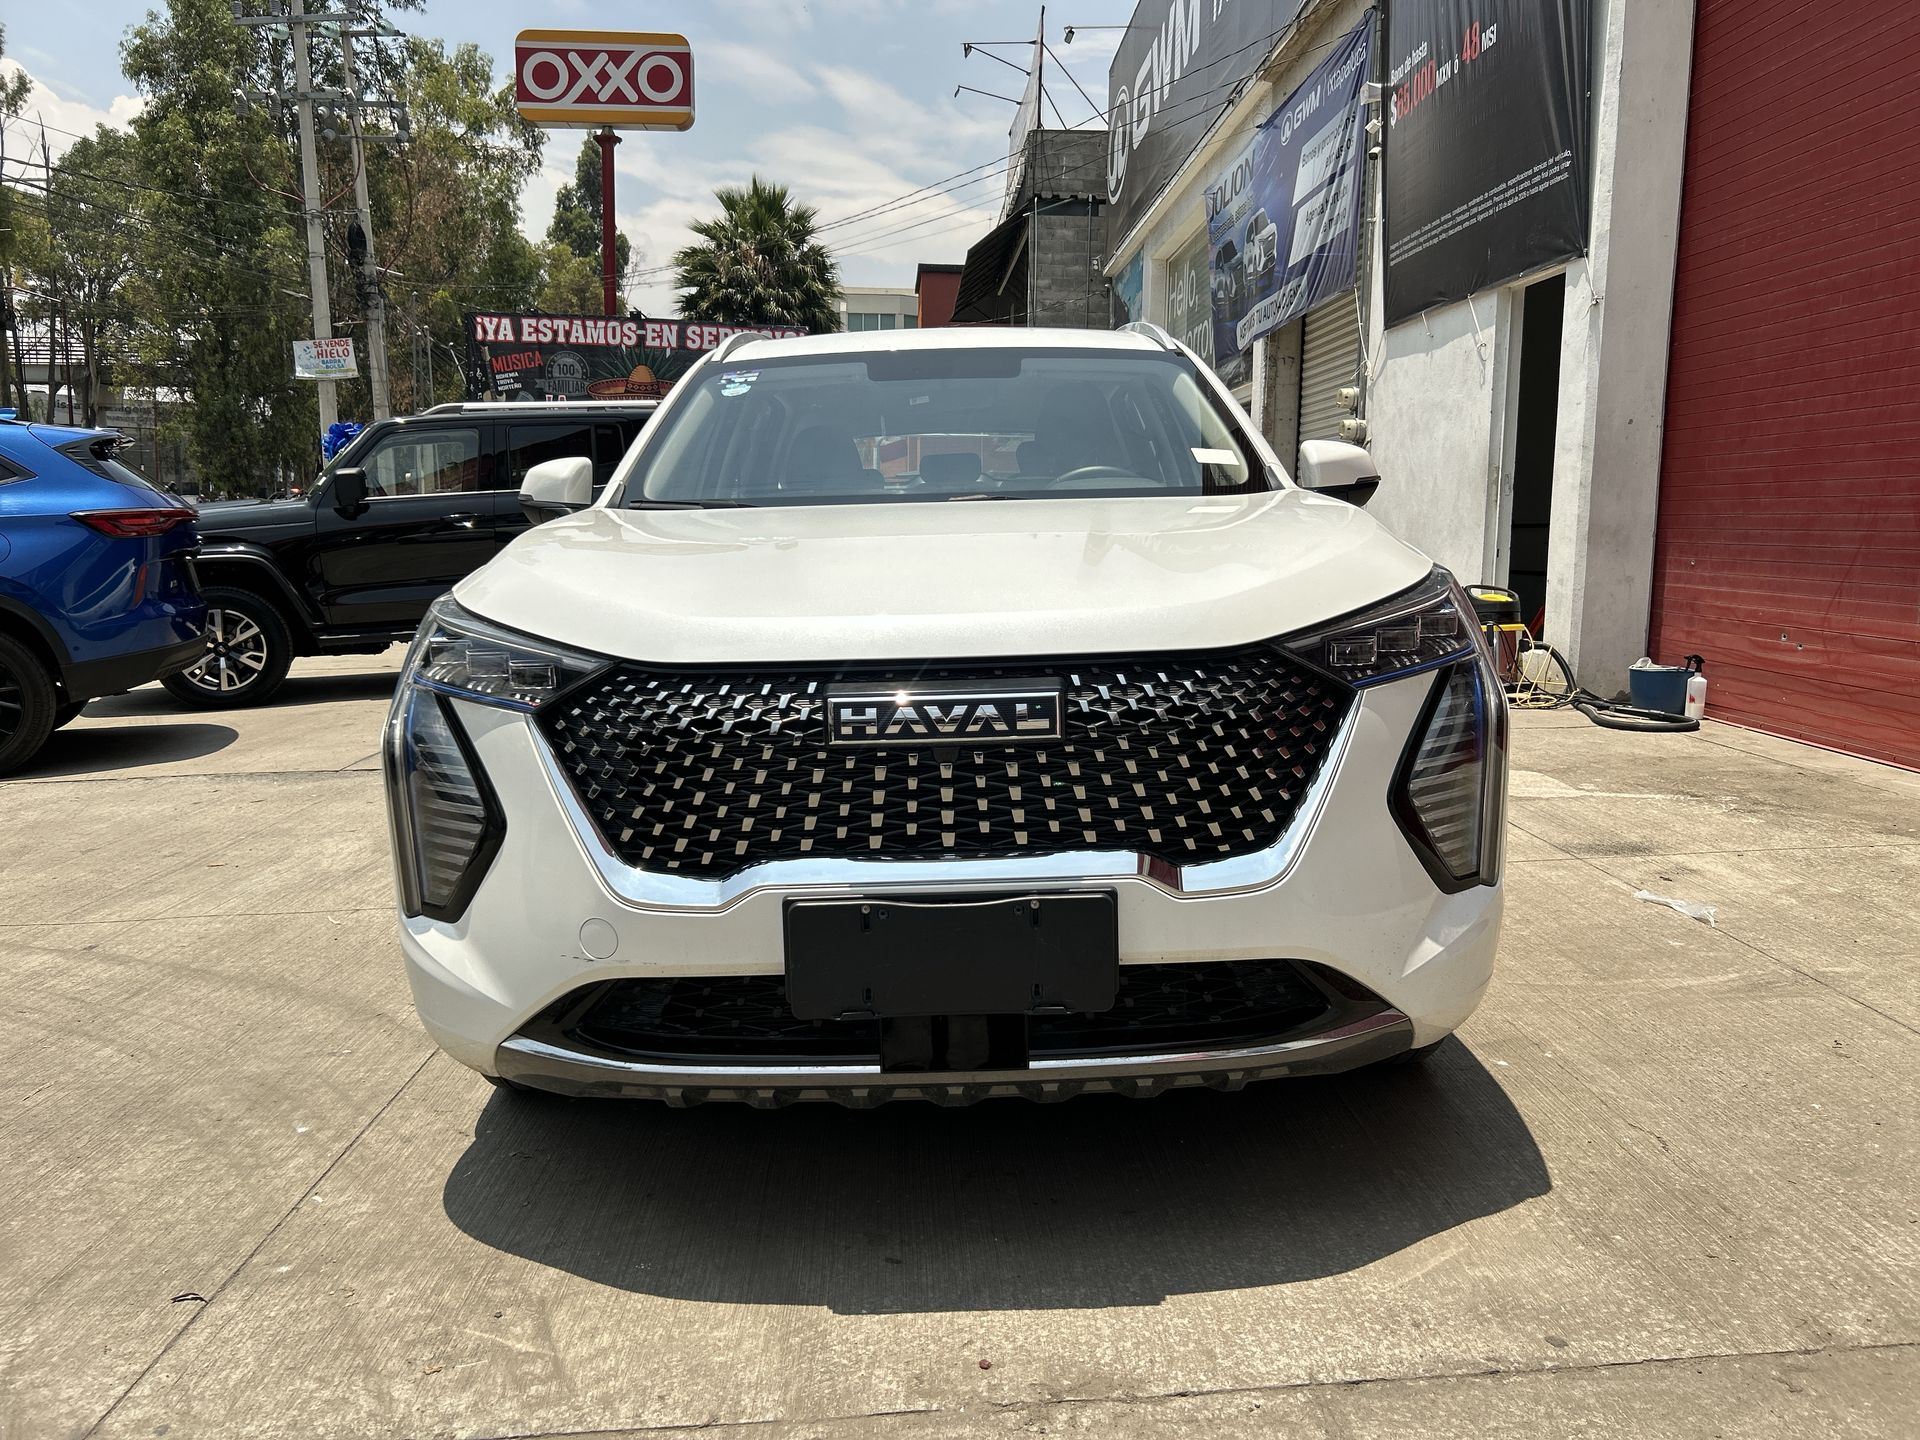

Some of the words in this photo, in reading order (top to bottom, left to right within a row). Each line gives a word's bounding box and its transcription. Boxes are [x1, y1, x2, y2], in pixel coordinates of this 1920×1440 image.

[1390, 64, 1404, 87] Bono
[1404, 56, 1412, 74] de
[1412, 40, 1428, 67] hasta
[1436, 60, 1452, 88] MXN
[1454, 54, 1459, 74] ó
[1461, 20, 1480, 65] 48
[1481, 23, 1497, 52] MSI
[522, 51, 684, 104] OXXO
[1132, 0, 1200, 150] GWM
[1294, 84, 1320, 130] GWM
[1209, 149, 1256, 223] JOLION
[1168, 260, 1199, 323] Hello,
[324, 339, 350, 348] VENDE
[474, 316, 515, 342] ¡YA
[521, 317, 638, 347] ESTAMOS
[644, 322, 678, 348] EN
[316, 348, 350, 359] HIELO
[492, 350, 544, 373] MUSICA
[496, 372, 519, 380] BOHEMIA
[498, 383, 522, 391] NORTEÑO
[548, 380, 586, 394] FAMILIAR
[840, 704, 1050, 734] HAVAL
